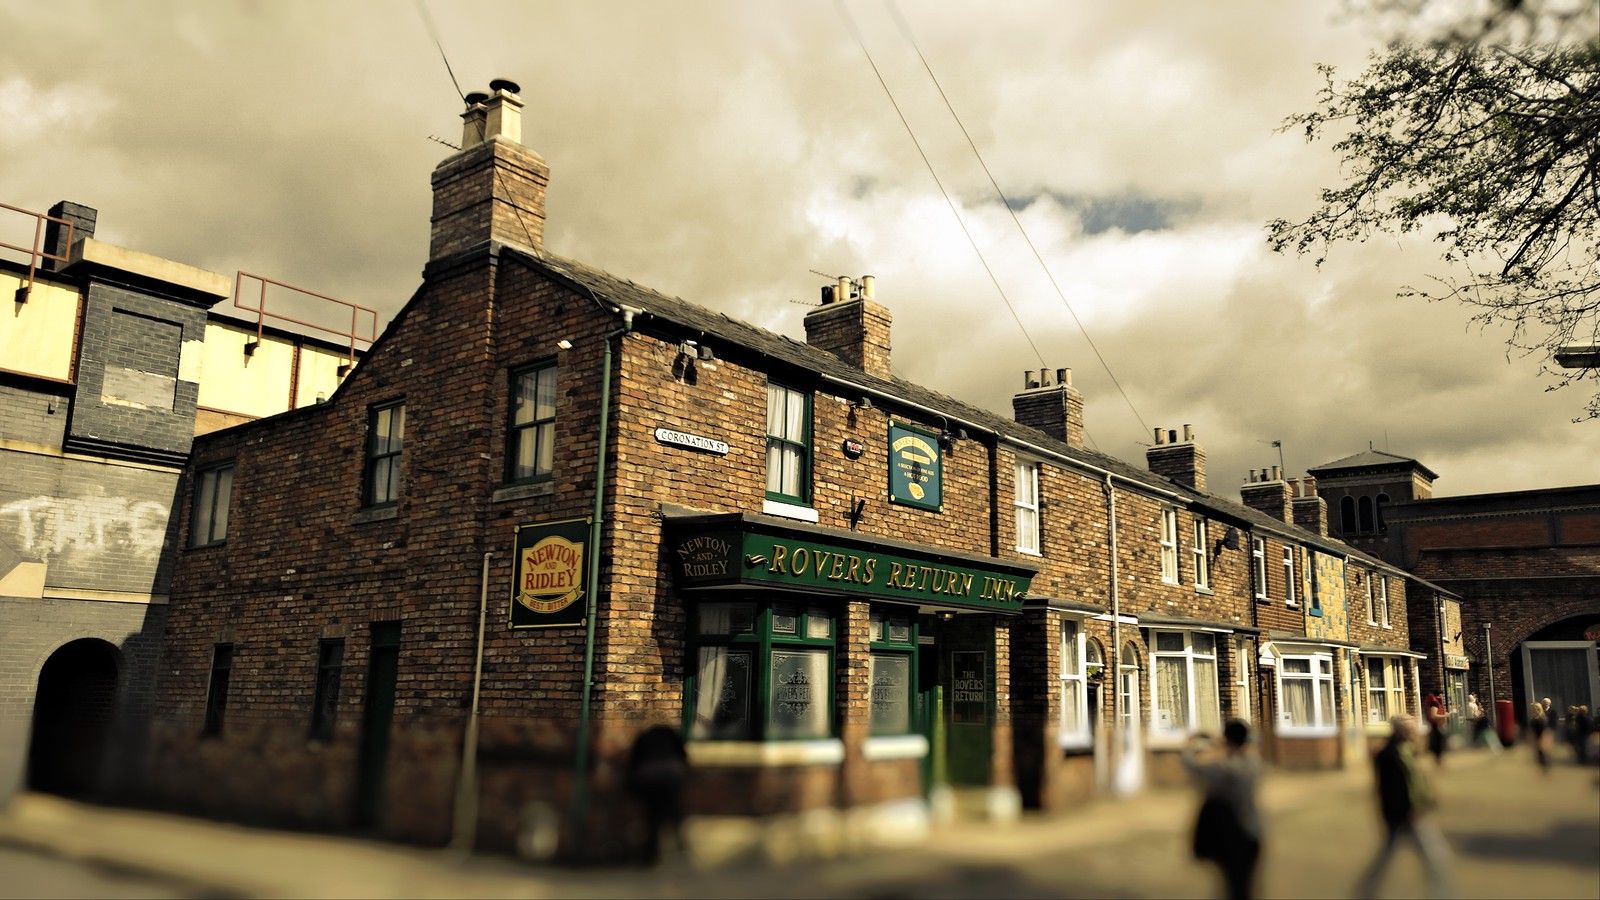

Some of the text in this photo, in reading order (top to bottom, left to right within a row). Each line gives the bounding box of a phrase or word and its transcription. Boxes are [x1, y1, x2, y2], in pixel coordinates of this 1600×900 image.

[661, 431, 725, 452] CORONATION ST
[676, 536, 732, 560] NEWTON
[526, 544, 580, 571] NEWTON
[543, 561, 557, 570] AND
[696, 552, 714, 562] AND
[683, 560, 729, 577] RIDLEY
[768, 544, 1016, 602] ROVERS RETURN INN
[525, 569, 576, 590] RIDLEY
[962, 670, 976, 680] THE
[954, 679, 984, 690] ROVERS
[954, 691, 984, 701] RETURN
